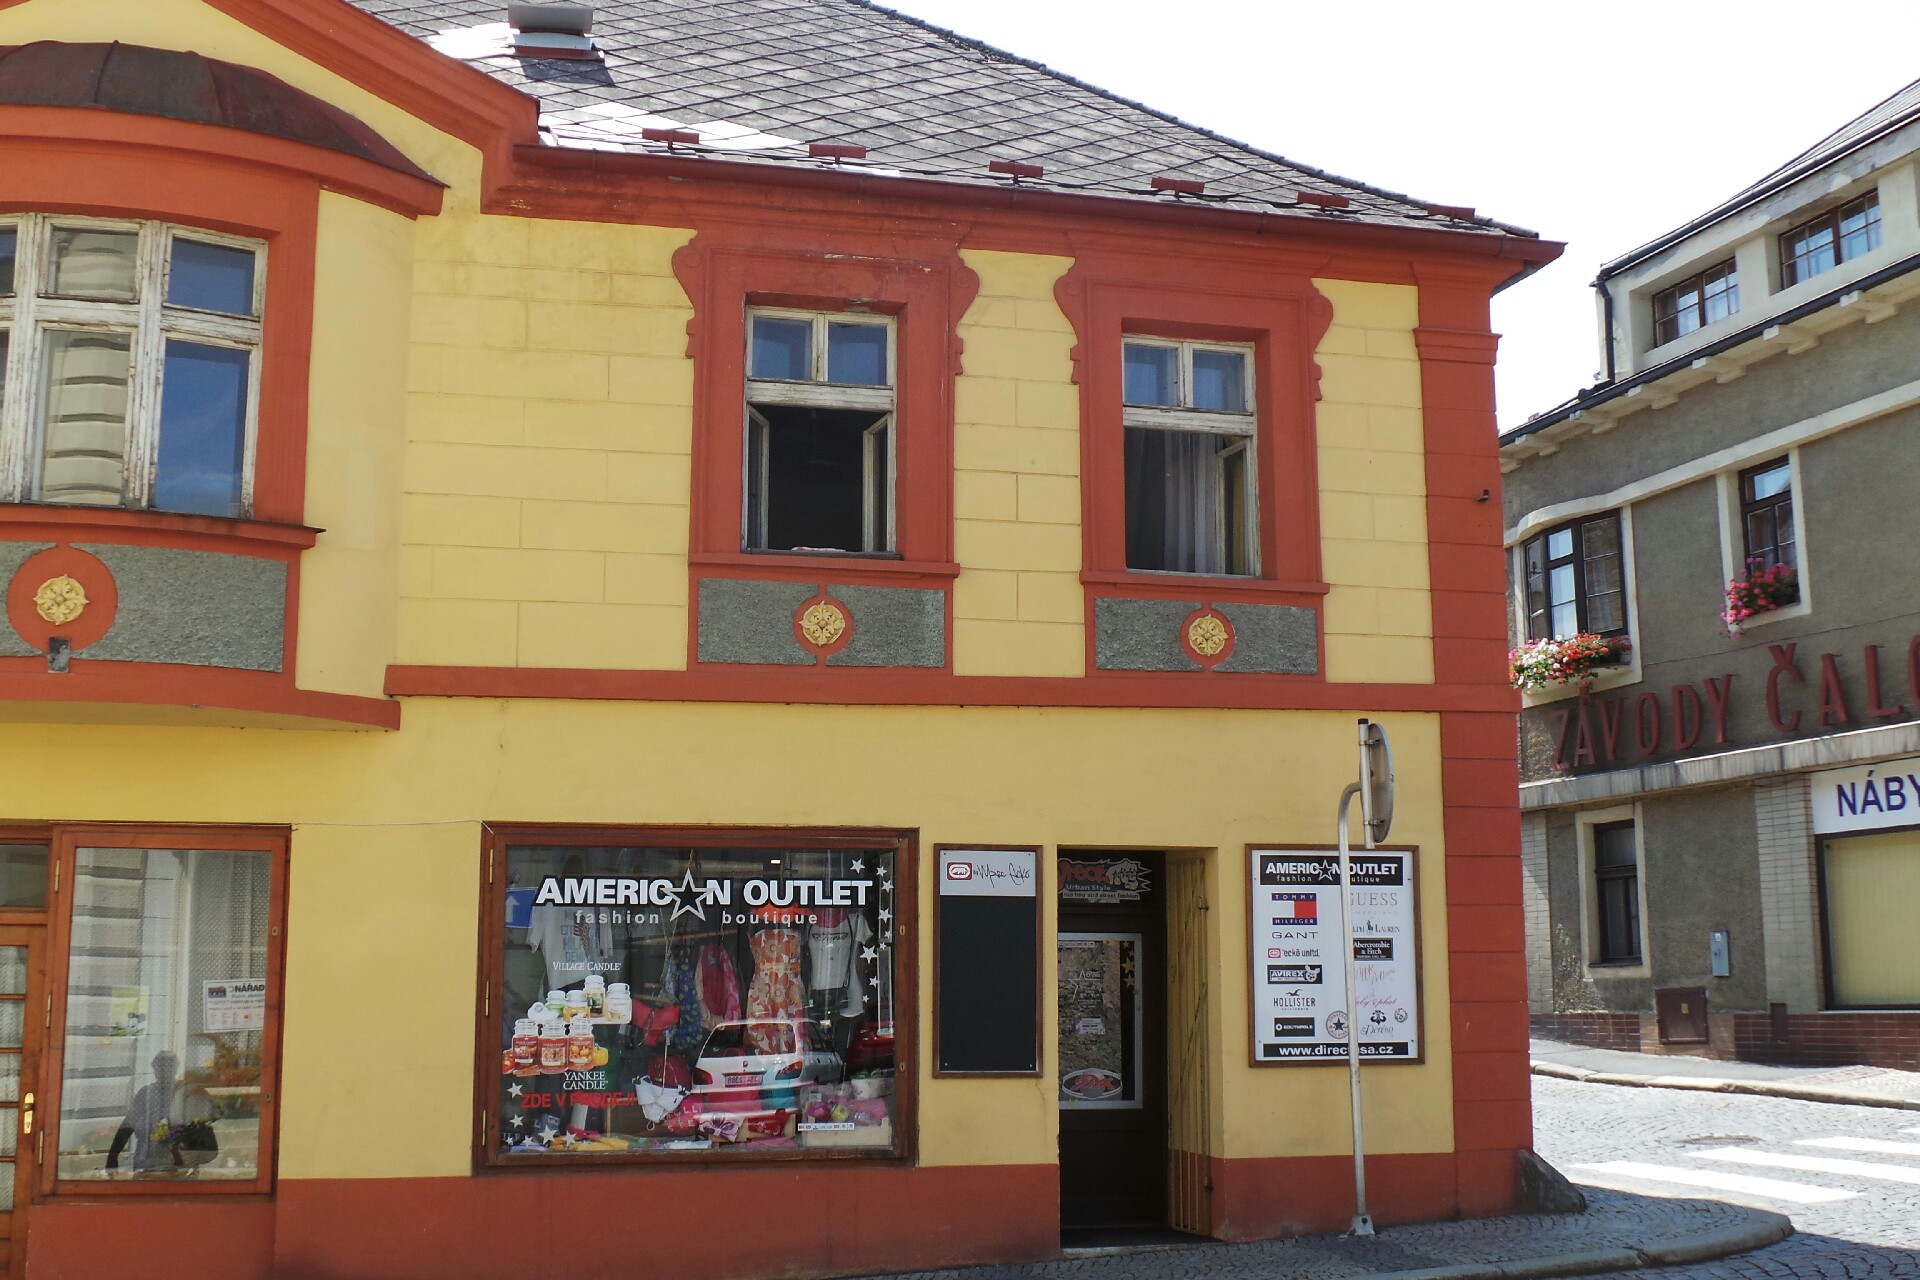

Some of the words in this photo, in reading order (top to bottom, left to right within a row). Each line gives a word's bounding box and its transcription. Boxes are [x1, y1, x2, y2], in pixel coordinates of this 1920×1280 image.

[1550, 674, 1732, 770] ZÁVODY
[1349, 863, 1398, 875] OUTLET
[1276, 874, 1312, 882] fashion
[1351, 876, 1380, 884] utique
[743, 879, 873, 906] OUTLET
[1092, 884, 1111, 892] Style
[575, 909, 659, 924] fashion
[722, 911, 818, 927] boutique
[1271, 931, 1319, 939] GANT
[1353, 940, 1391, 948] Abercrombie
[1367, 947, 1382, 955] Fitch
[1273, 997, 1316, 1007] HOLLISTER
[1279, 1045, 1394, 1056] www.direcsa.cz
[564, 1071, 606, 1081] YANKEE
[562, 1081, 606, 1090] CANDLE
[521, 1093, 551, 1109] ZDE
[557, 1092, 567, 1107] V
